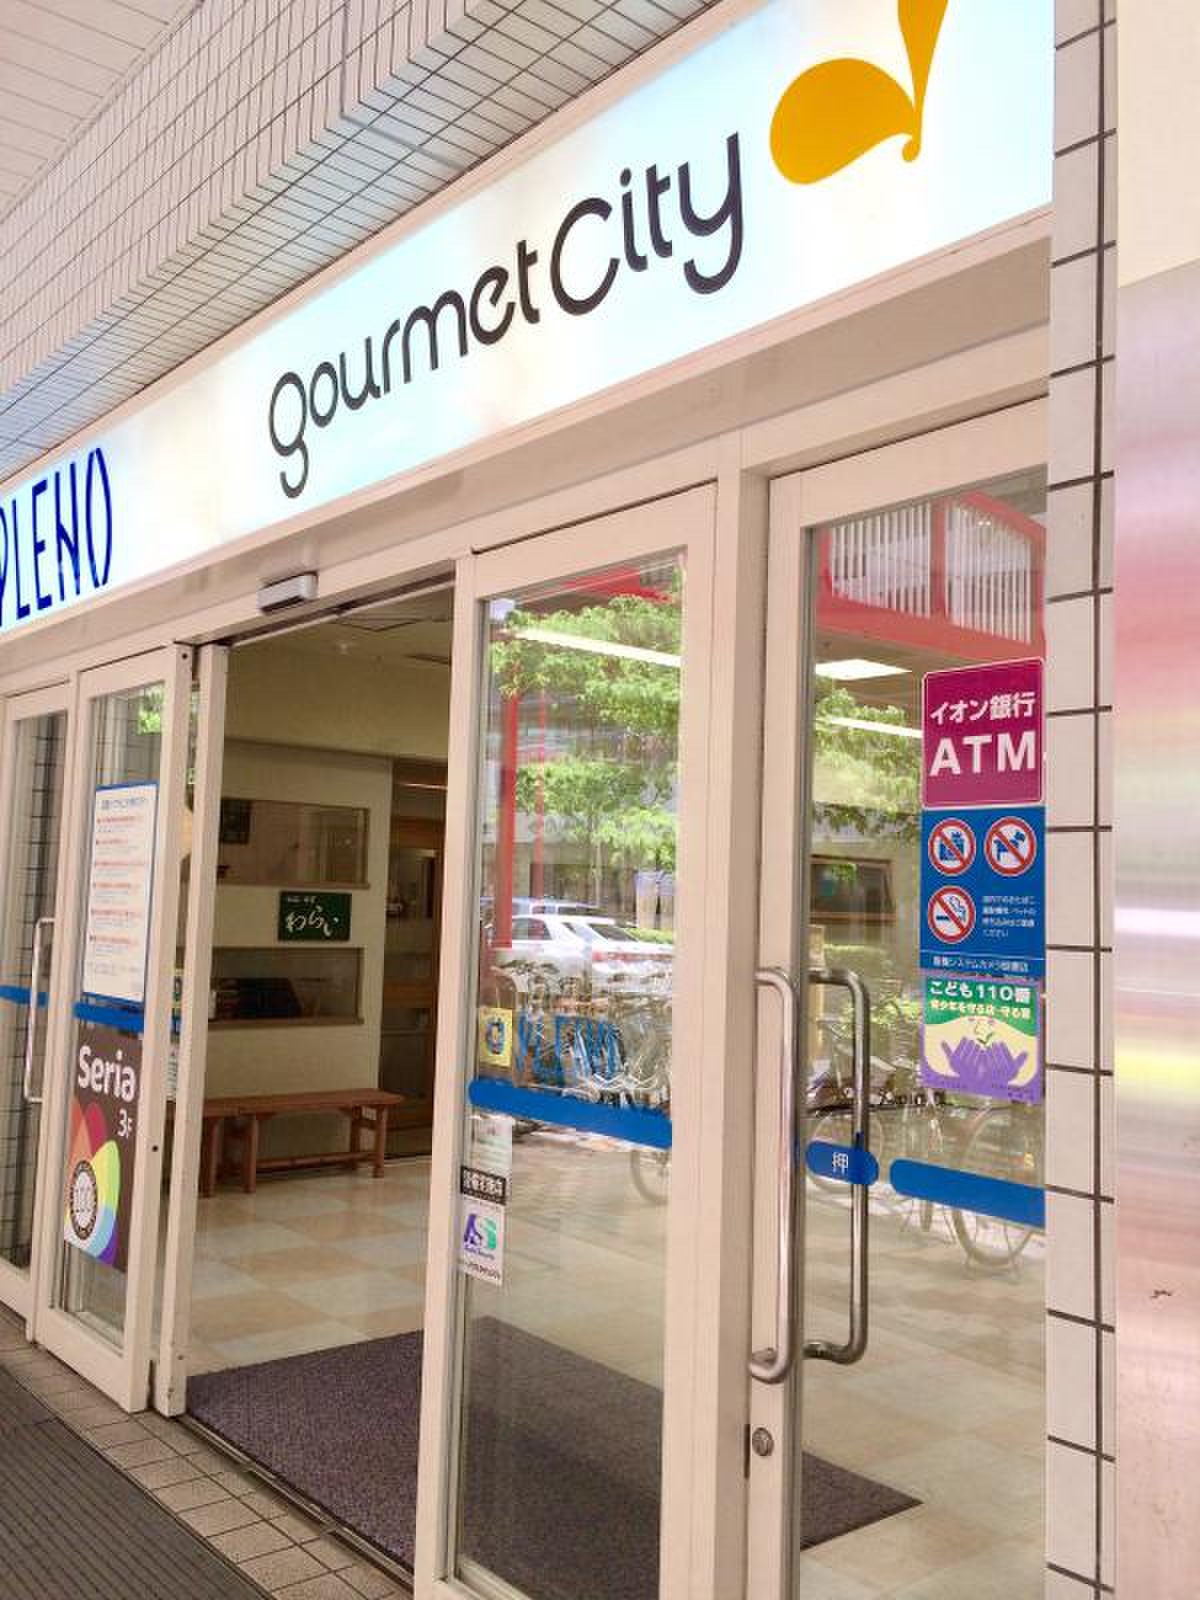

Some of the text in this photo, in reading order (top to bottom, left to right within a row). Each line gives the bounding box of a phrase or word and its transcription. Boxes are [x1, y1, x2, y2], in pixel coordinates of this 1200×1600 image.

[268, 131, 745, 499] gourmet City
[930, 691, 1036, 726] イオン銀行
[928, 730, 1036, 777] ATM
[77, 1043, 137, 1102] Seria
